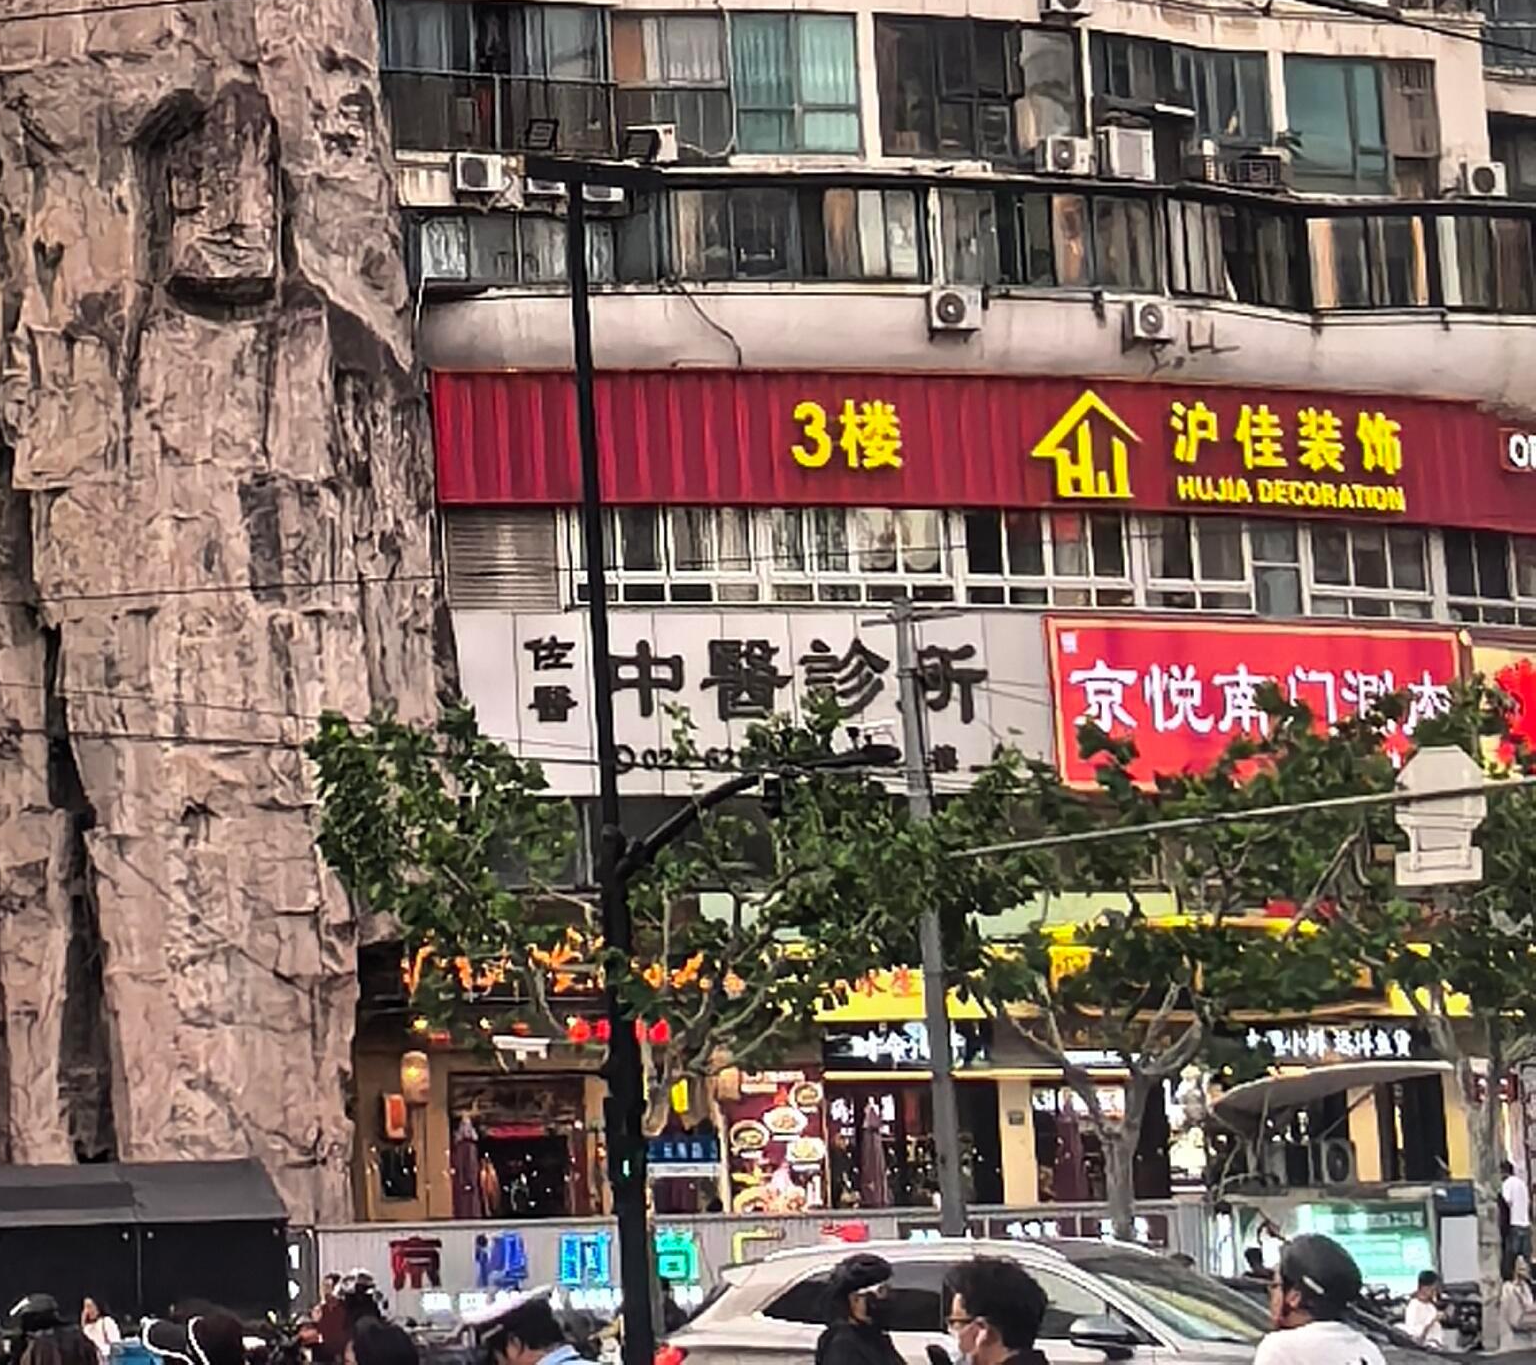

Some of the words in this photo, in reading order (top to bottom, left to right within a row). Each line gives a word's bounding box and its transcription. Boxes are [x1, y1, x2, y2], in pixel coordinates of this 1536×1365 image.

[791, 399, 903, 469] 3楼
[1170, 401, 1402, 475] 沪佳装饰
[1177, 475, 1253, 503] HUJIA
[1257, 479, 1406, 512] DECORATION
[608, 638, 988, 725] 中醫診所
